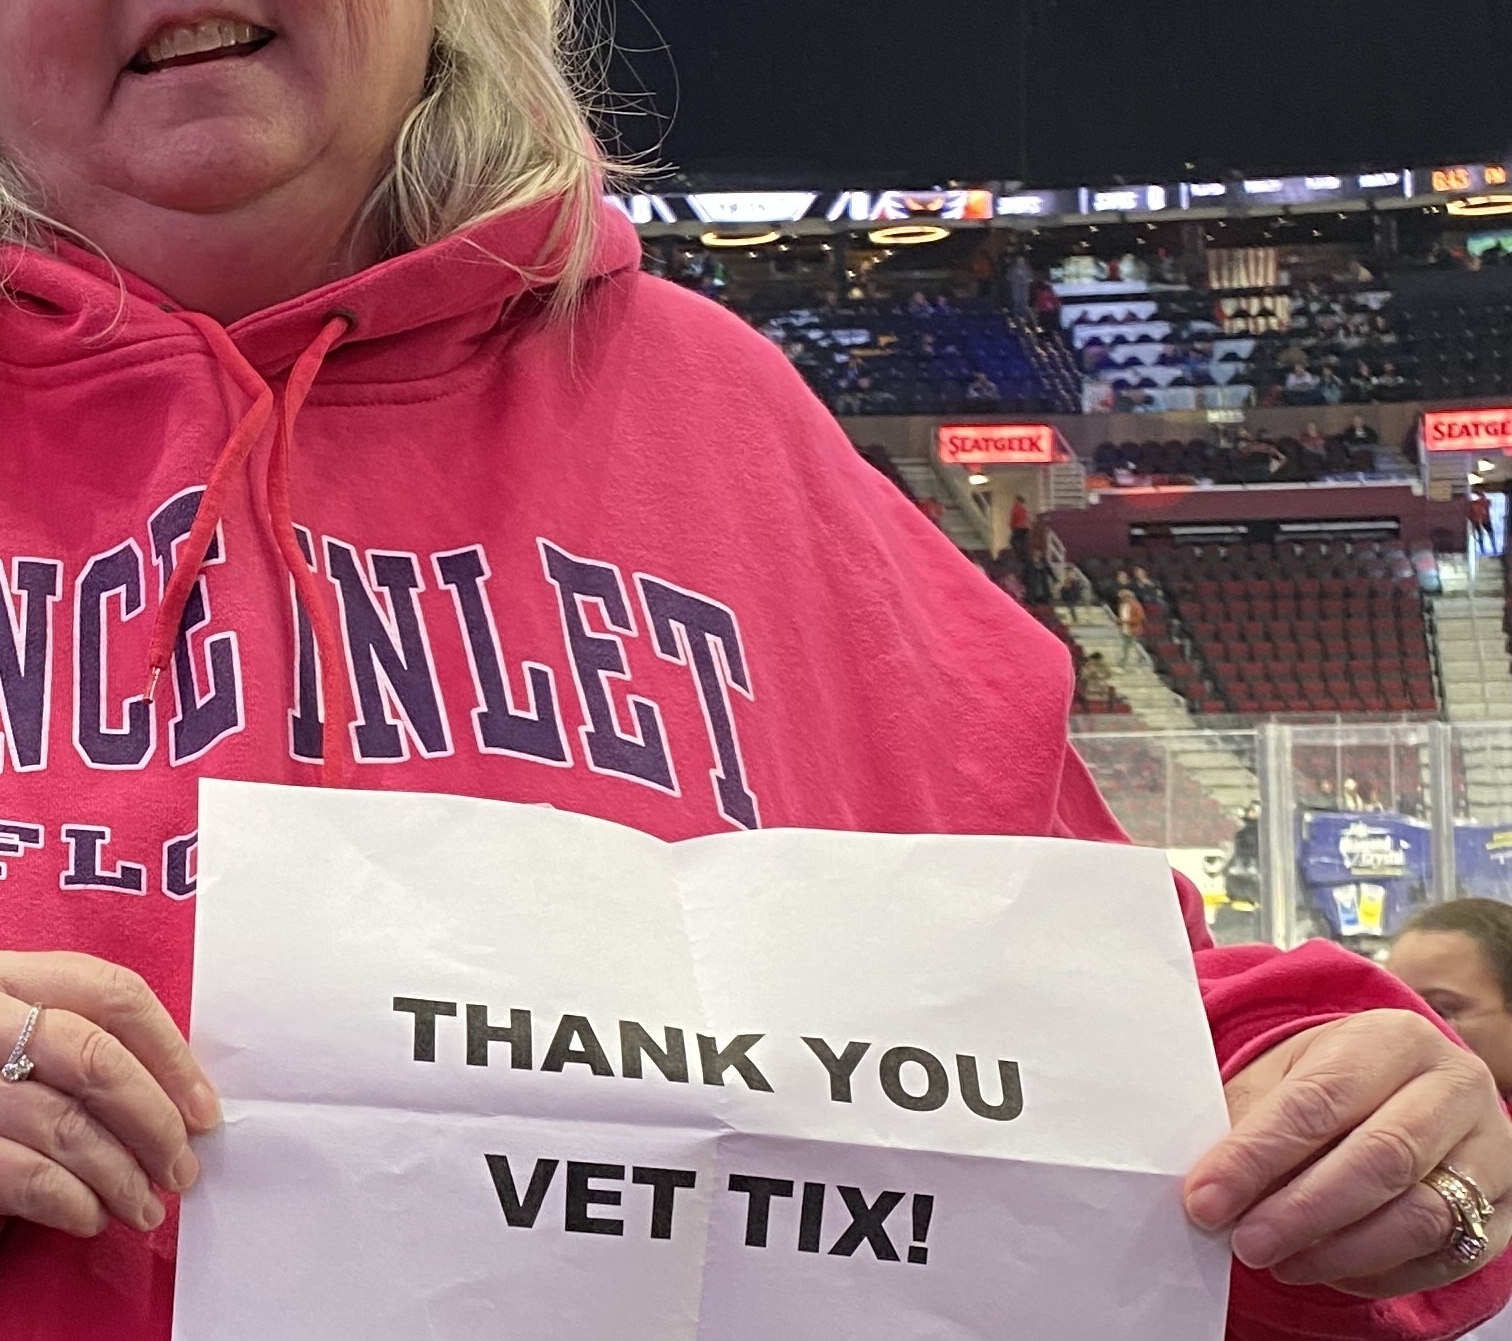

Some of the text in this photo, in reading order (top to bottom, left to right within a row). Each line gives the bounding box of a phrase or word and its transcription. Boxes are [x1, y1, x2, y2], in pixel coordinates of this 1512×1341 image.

[949, 435, 1043, 458] SEATGEEK
[288, 522, 761, 829] INLET
[393, 997, 1025, 1122] THANK YOU
[484, 1153, 935, 1265] VET TIX!
